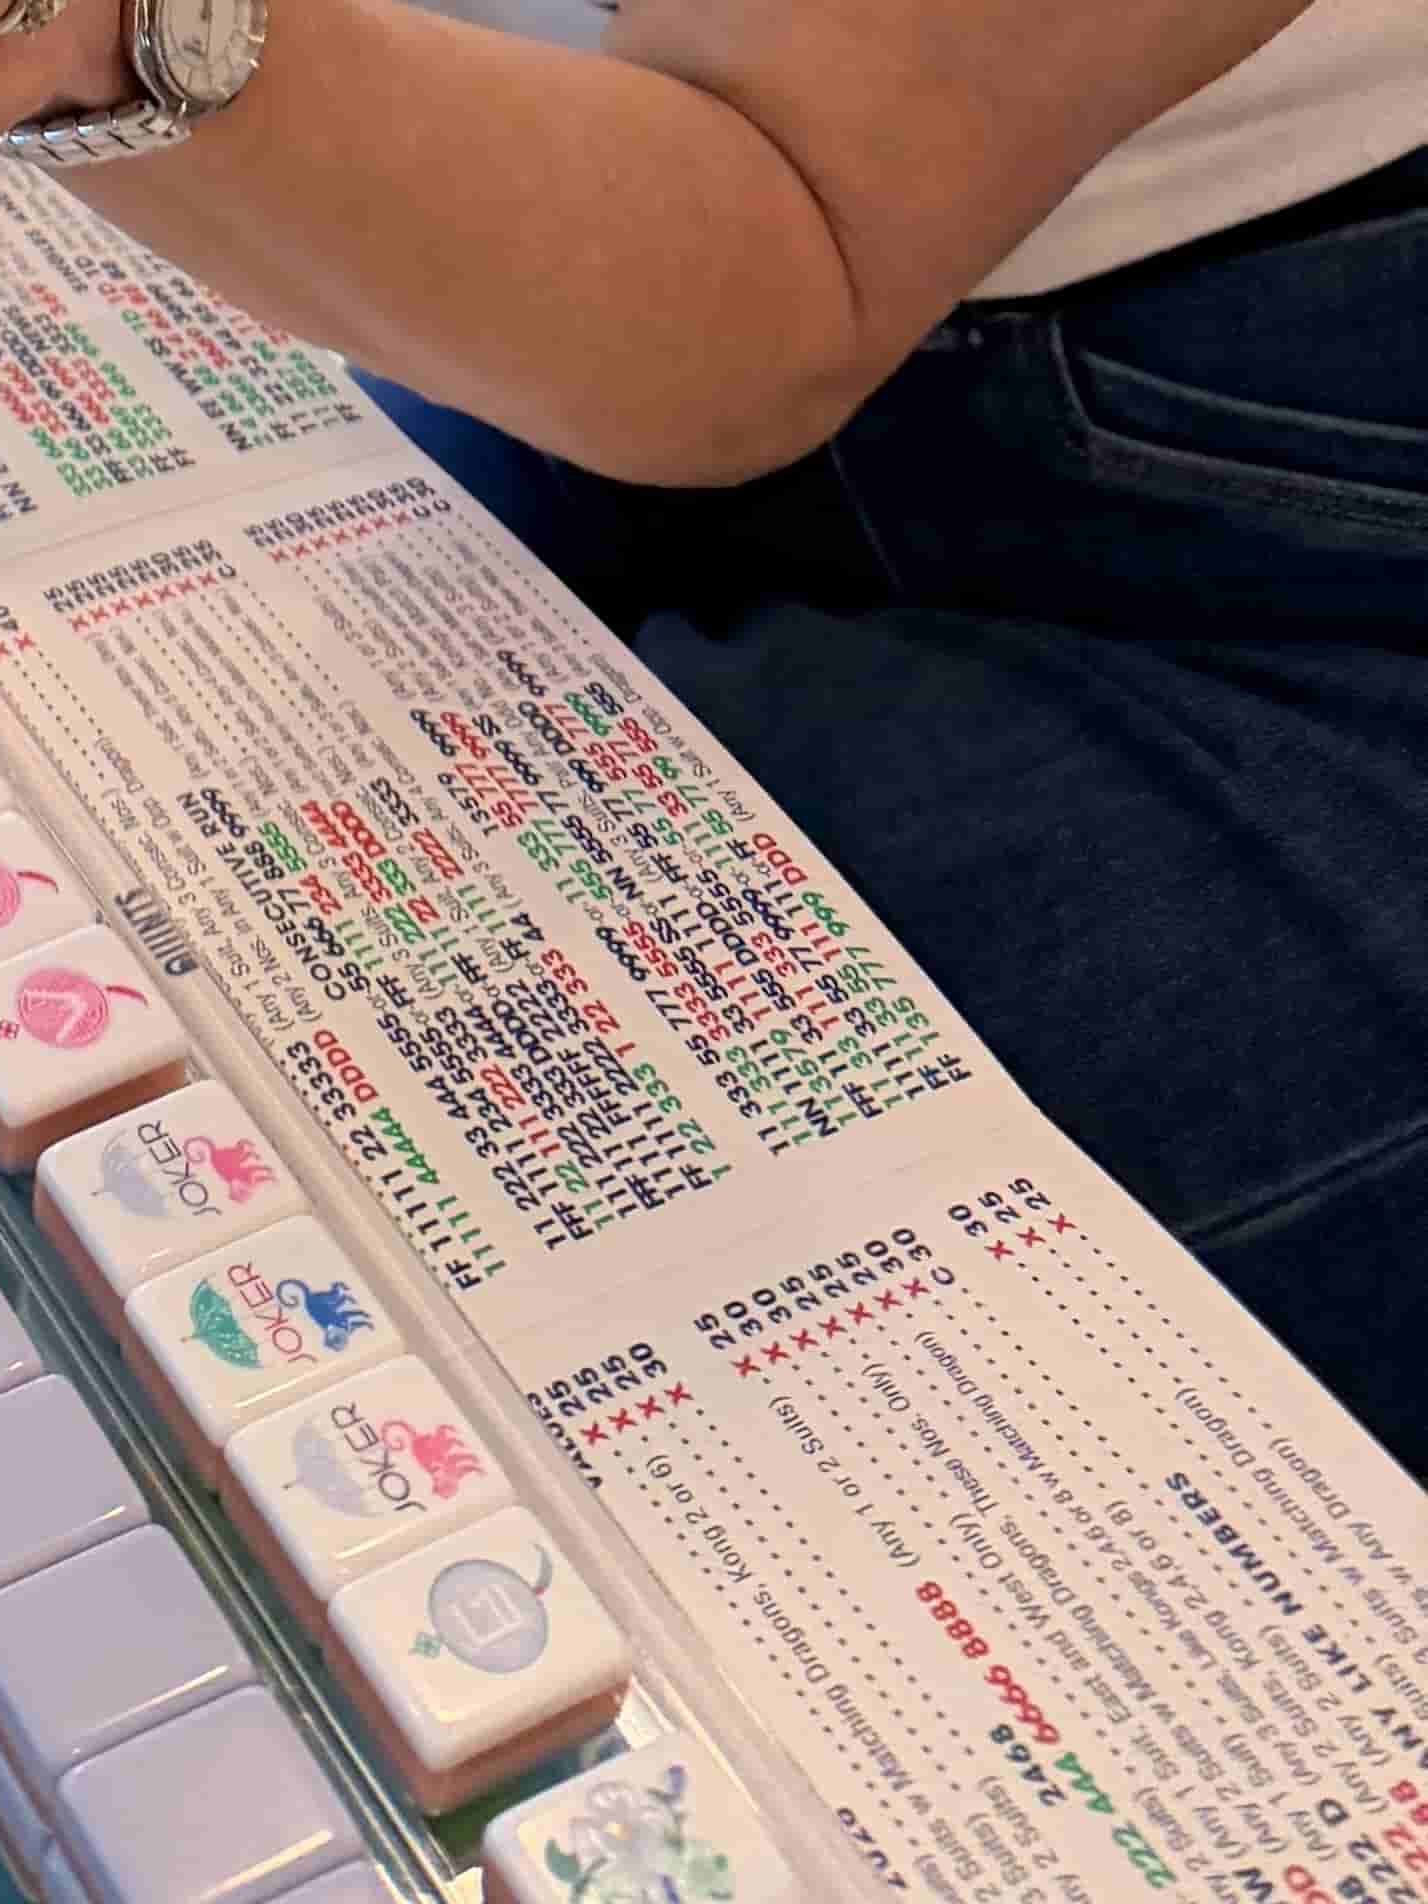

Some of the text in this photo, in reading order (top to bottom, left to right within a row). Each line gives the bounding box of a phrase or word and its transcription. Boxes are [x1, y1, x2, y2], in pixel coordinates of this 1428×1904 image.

[176, 792, 221, 838] RUN
[438, 773, 499, 837] 13579
[216, 842, 346, 1000] CONSECUTIVE
[510, 912, 544, 941] 44
[541, 949, 588, 995] 333
[752, 833, 972, 1082] FF 135 777 999 DDD
[582, 1000, 620, 1034] 22
[713, 960, 771, 1021] 1111
[435, 1006, 614, 1230] 11 22 111 222 3333
[505, 978, 685, 1199] 1111 FFFFFF 2222
[633, 1063, 682, 1113] 333
[286, 1041, 482, 1290] FF 11111 22 33333
[314, 1030, 506, 1277] 11111 44444 DDDD
[677, 1118, 716, 1154] 22
[137, 1118, 224, 1219] JOKER
[948, 1205, 1014, 1261] X 30
[226, 1261, 319, 1366] JOKER
[694, 1314, 736, 1349] 25
[752, 1288, 792, 1324] 30
[731, 1355, 762, 1378] X
[789, 1328, 819, 1351] X
[1008, 1178, 1393, 1560] Any Dragon) X 25
[629, 1343, 693, 1405] X 30
[779, 1276, 1000, 1517] These Nos. Only) X 25
[978, 1192, 1344, 1563] Matching Dragon) X 25
[545, 1380, 610, 1445] X 25
[768, 1397, 824, 1454] Suits)
[330, 1402, 427, 1514] JOKER
[817, 1457, 840, 1472] 2
[832, 1477, 860, 1496] or
[892, 1229, 1392, 1766] (Any 2 Suits) C 30
[870, 1521, 920, 1567] (Any
[949, 1513, 1003, 1568] Only)
[572, 1368, 912, 1792] Matching Dragons, Kong 2 or 6) X 25
[997, 1572, 1051, 1629] West
[1166, 1472, 1372, 1692] LIKE NUMBERS
[916, 1582, 989, 1658] 8888
[1043, 1629, 1091, 1670] and
[984, 1665, 1060, 1744] 6666
[1083, 1674, 1133, 1724] East
[990, 1724, 1067, 1806] 2468
[1054, 1752, 1115, 1814] 444
[1130, 1725, 1180, 1780] Suit,
[1112, 1821, 1177, 1889] 222
[1192, 1806, 1250, 1859] (Any
